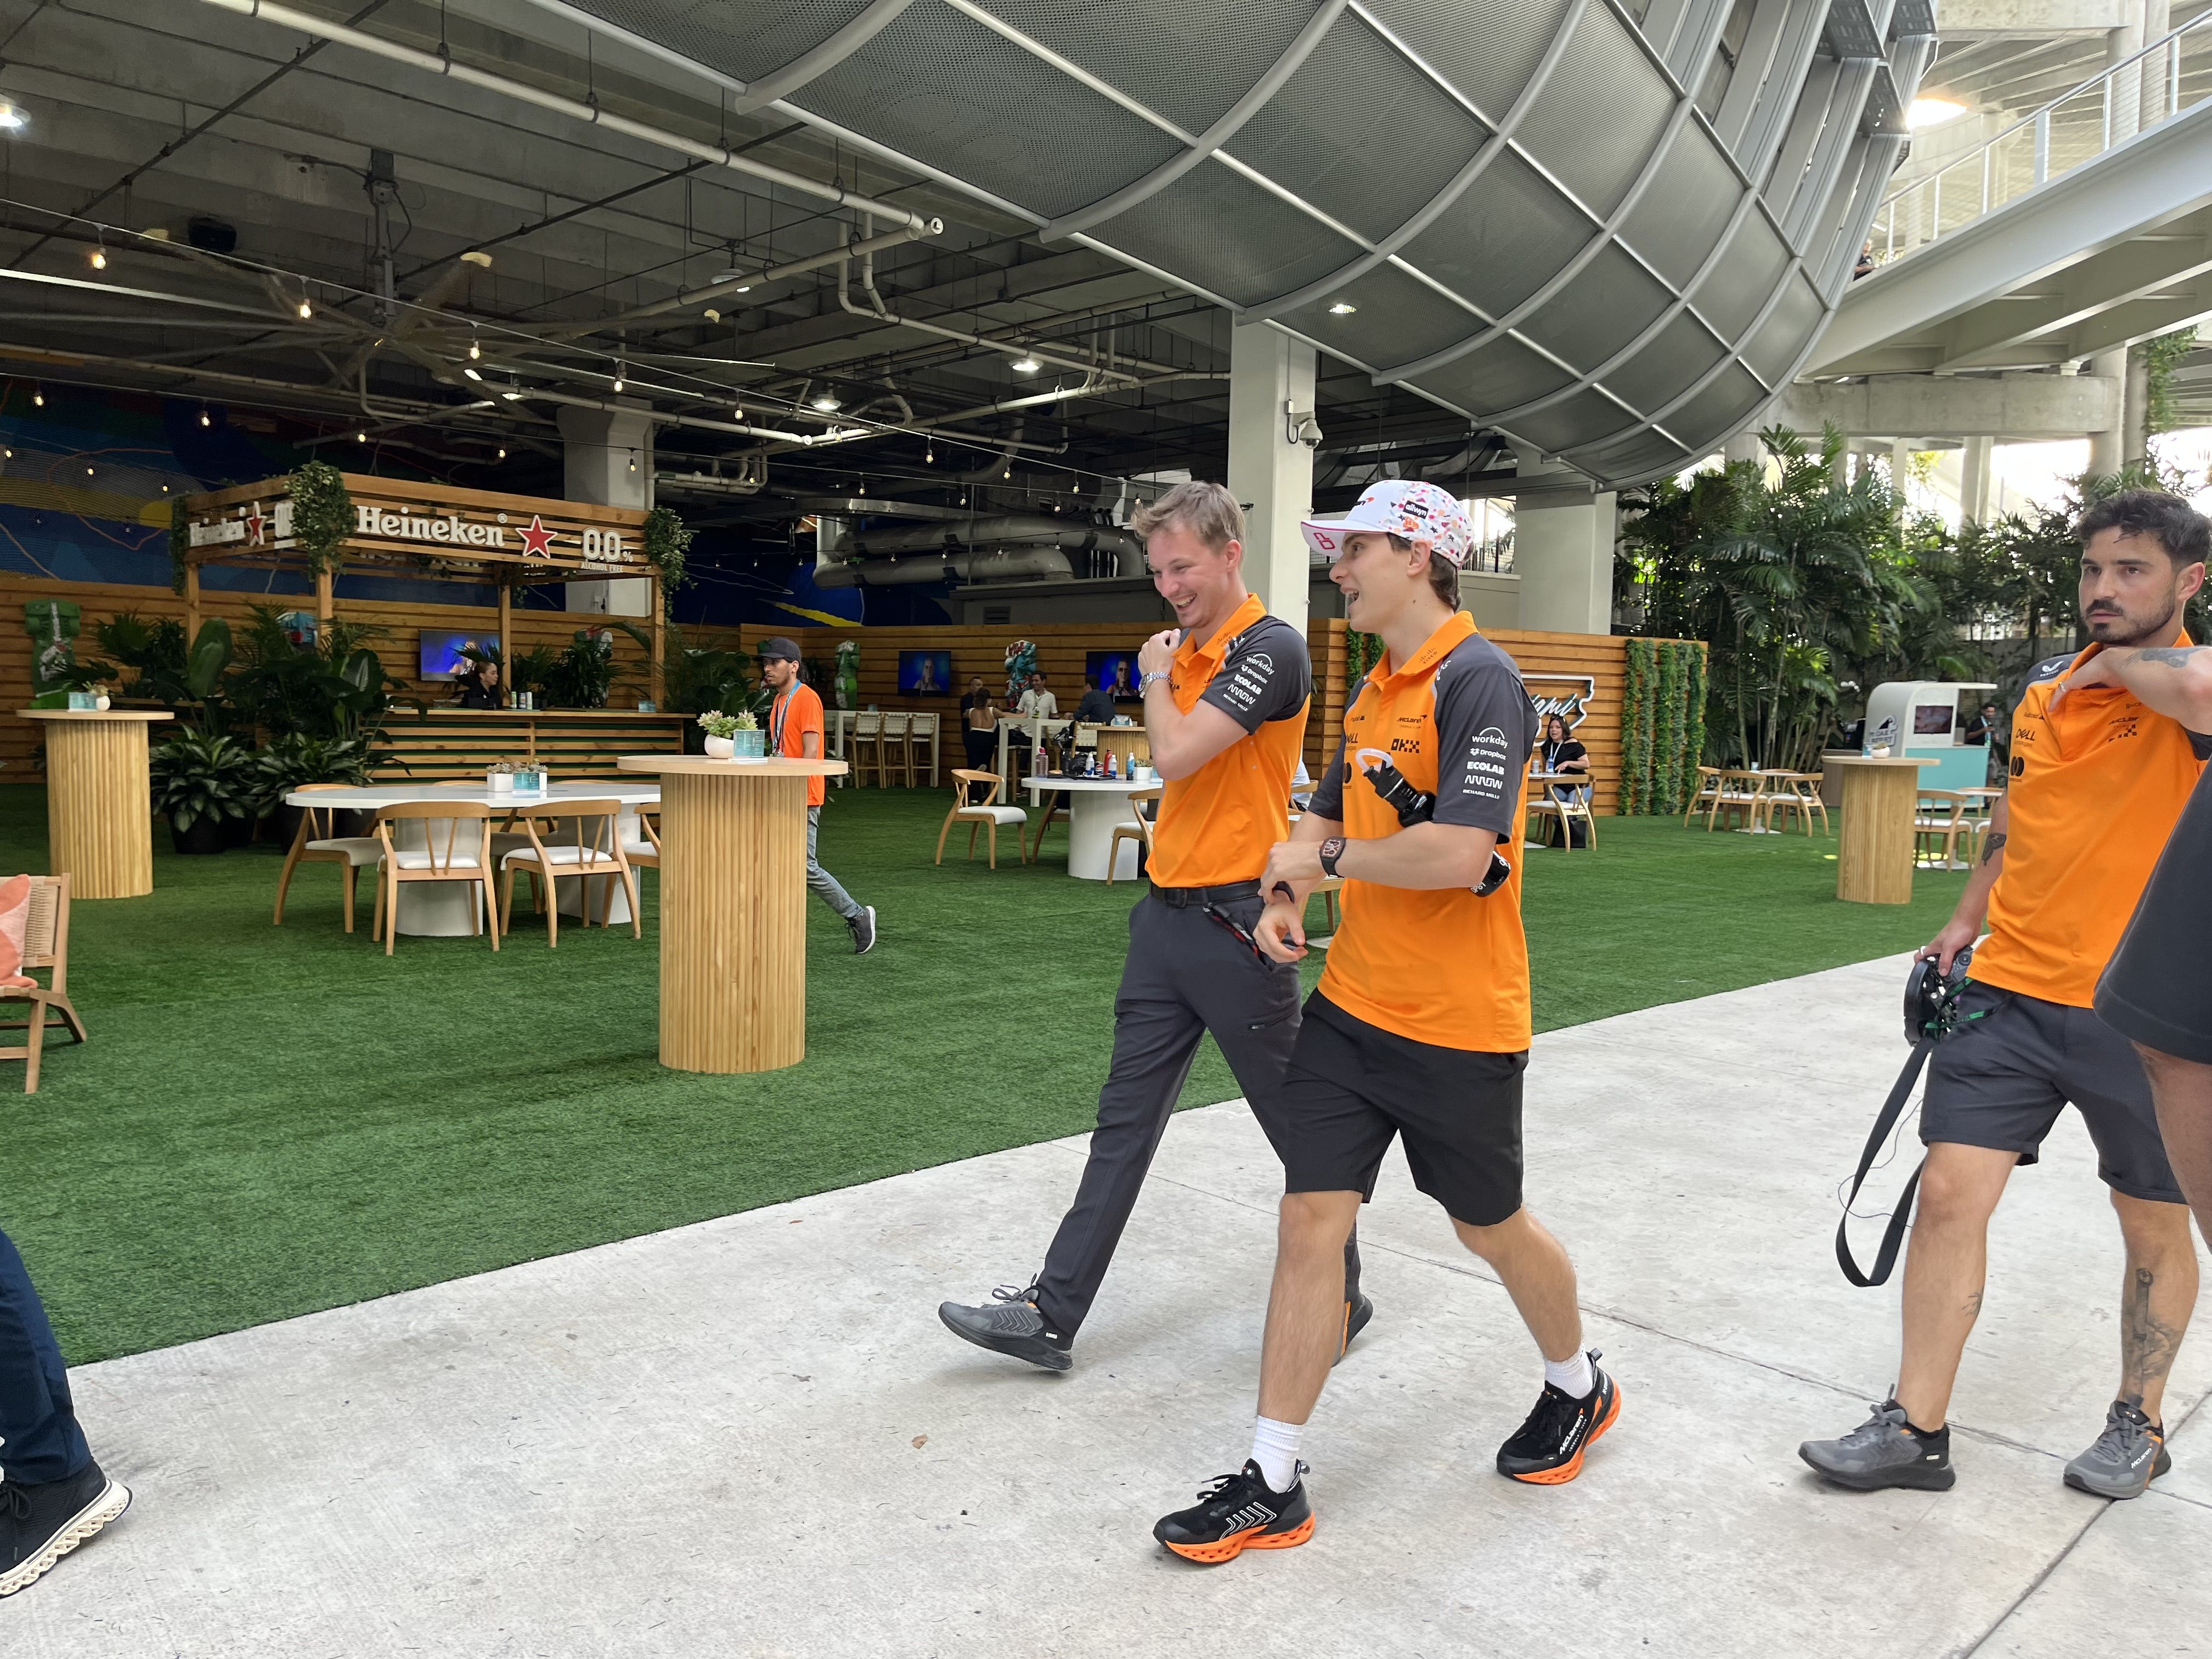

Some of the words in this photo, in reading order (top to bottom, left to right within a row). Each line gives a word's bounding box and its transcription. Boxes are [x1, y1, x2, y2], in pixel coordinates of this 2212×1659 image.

[1405, 503, 1427, 517] allwyn
[580, 560, 608, 572] ALCOHOL
[609, 564, 624, 573] FREE
[1246, 656, 1275, 675] workday
[1247, 668, 1268, 685] Dropbox
[1234, 674, 1262, 695] ECOLAB
[1391, 738, 1420, 754] OKX
[1472, 735, 1508, 749] workday
[1480, 749, 1506, 761] Dropbox
[1466, 761, 1505, 775] ECOLAB
[1559, 1414, 1584, 1455] McLaren
